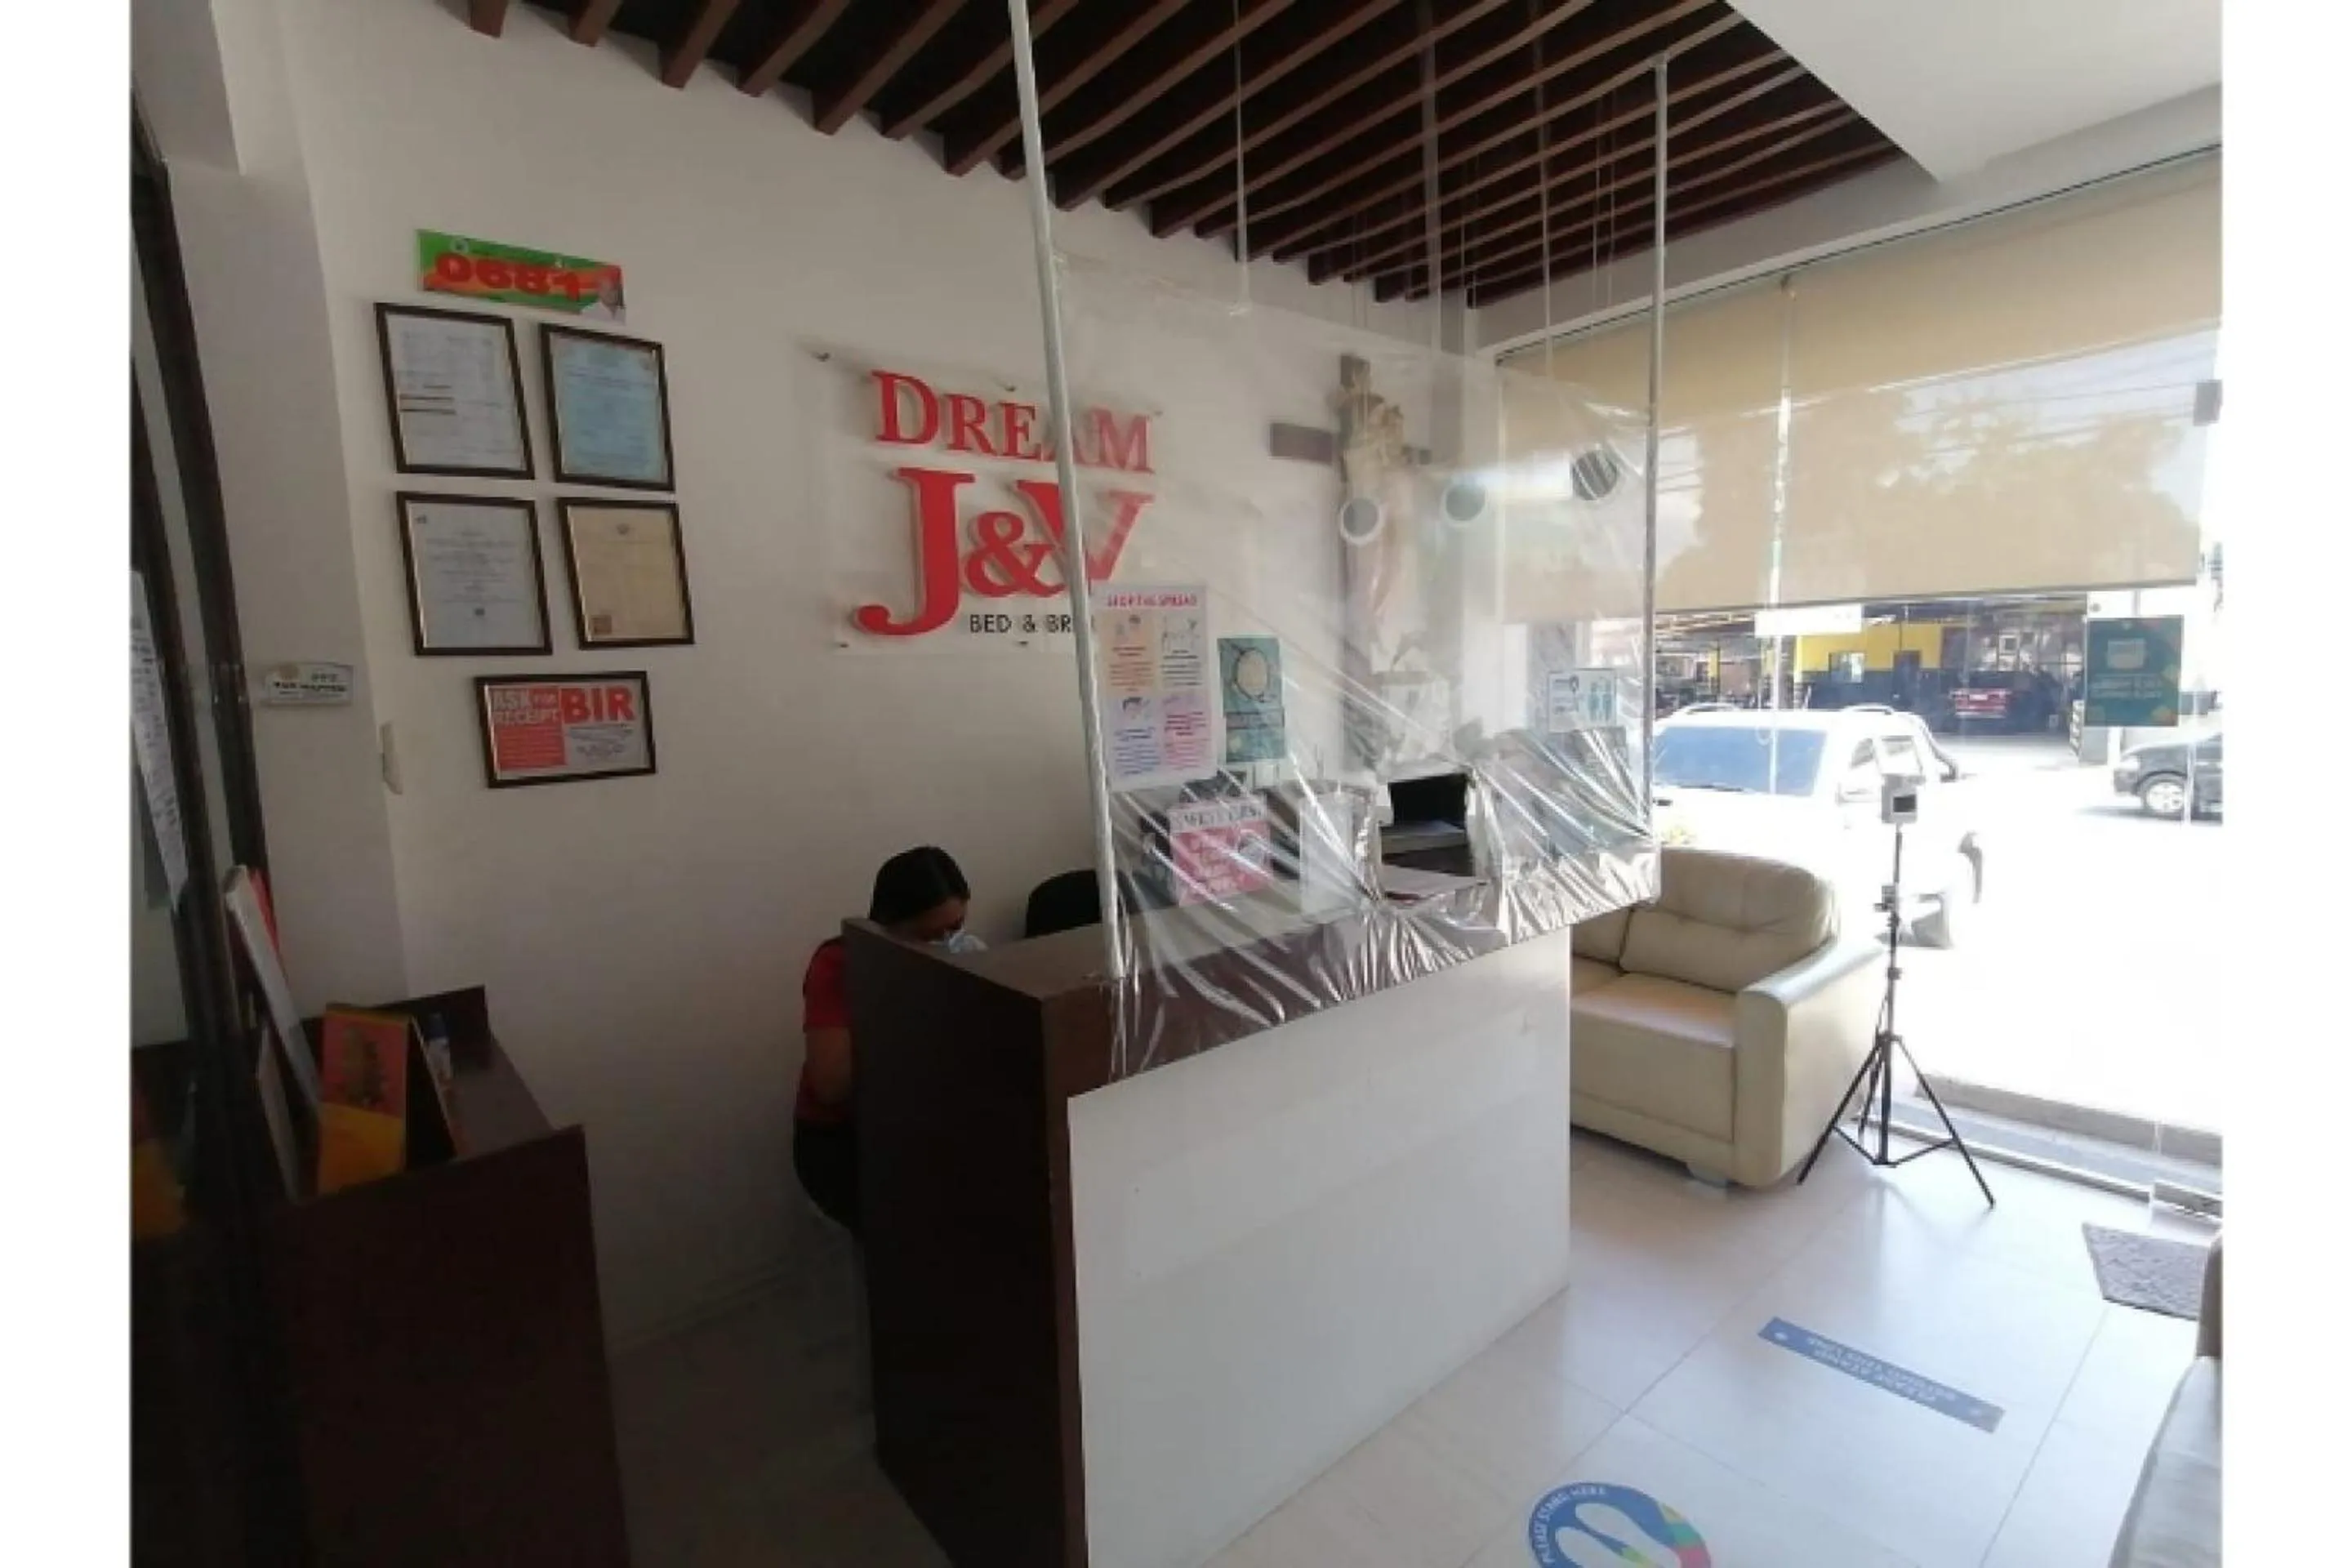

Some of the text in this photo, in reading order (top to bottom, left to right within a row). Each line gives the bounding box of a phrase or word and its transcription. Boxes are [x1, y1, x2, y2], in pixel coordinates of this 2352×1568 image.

[855, 466, 1156, 635] J&V
[969, 614, 1012, 633] BED
[1022, 614, 1037, 633] &
[560, 686, 635, 724] BIR
